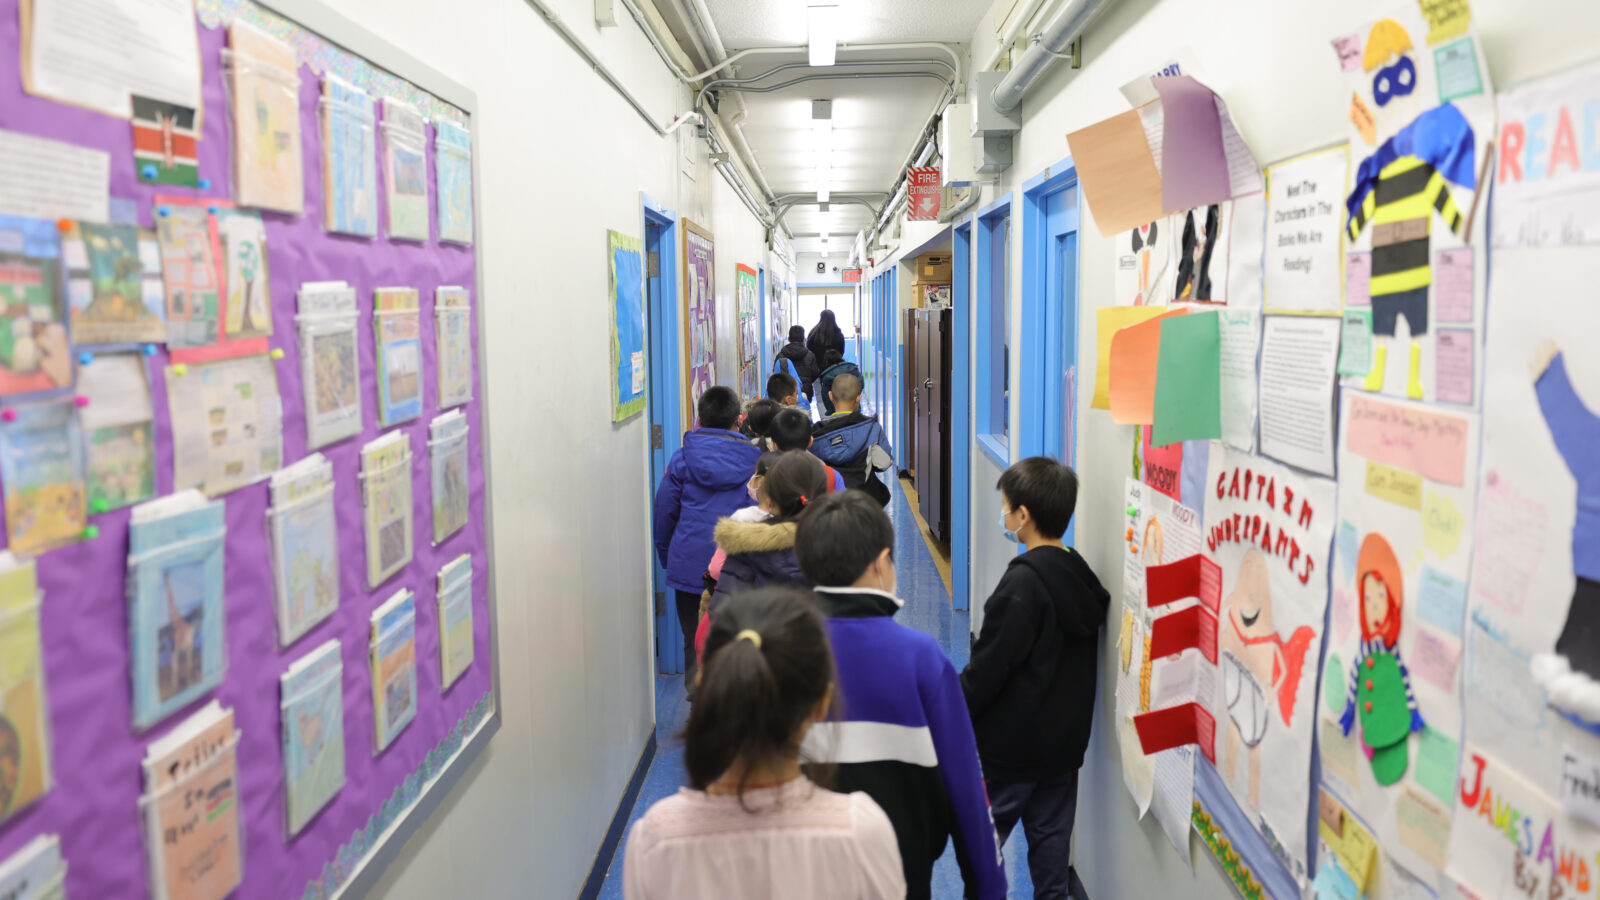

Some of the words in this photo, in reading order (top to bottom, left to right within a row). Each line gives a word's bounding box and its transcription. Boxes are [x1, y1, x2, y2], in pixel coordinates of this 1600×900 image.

[917, 173, 937, 184] FIRE
[1303, 180, 1317, 194] The
[1318, 201, 1332, 215] The
[1216, 466, 1314, 531] CAPTAIN
[1207, 512, 1314, 584] UNDERPANTS
